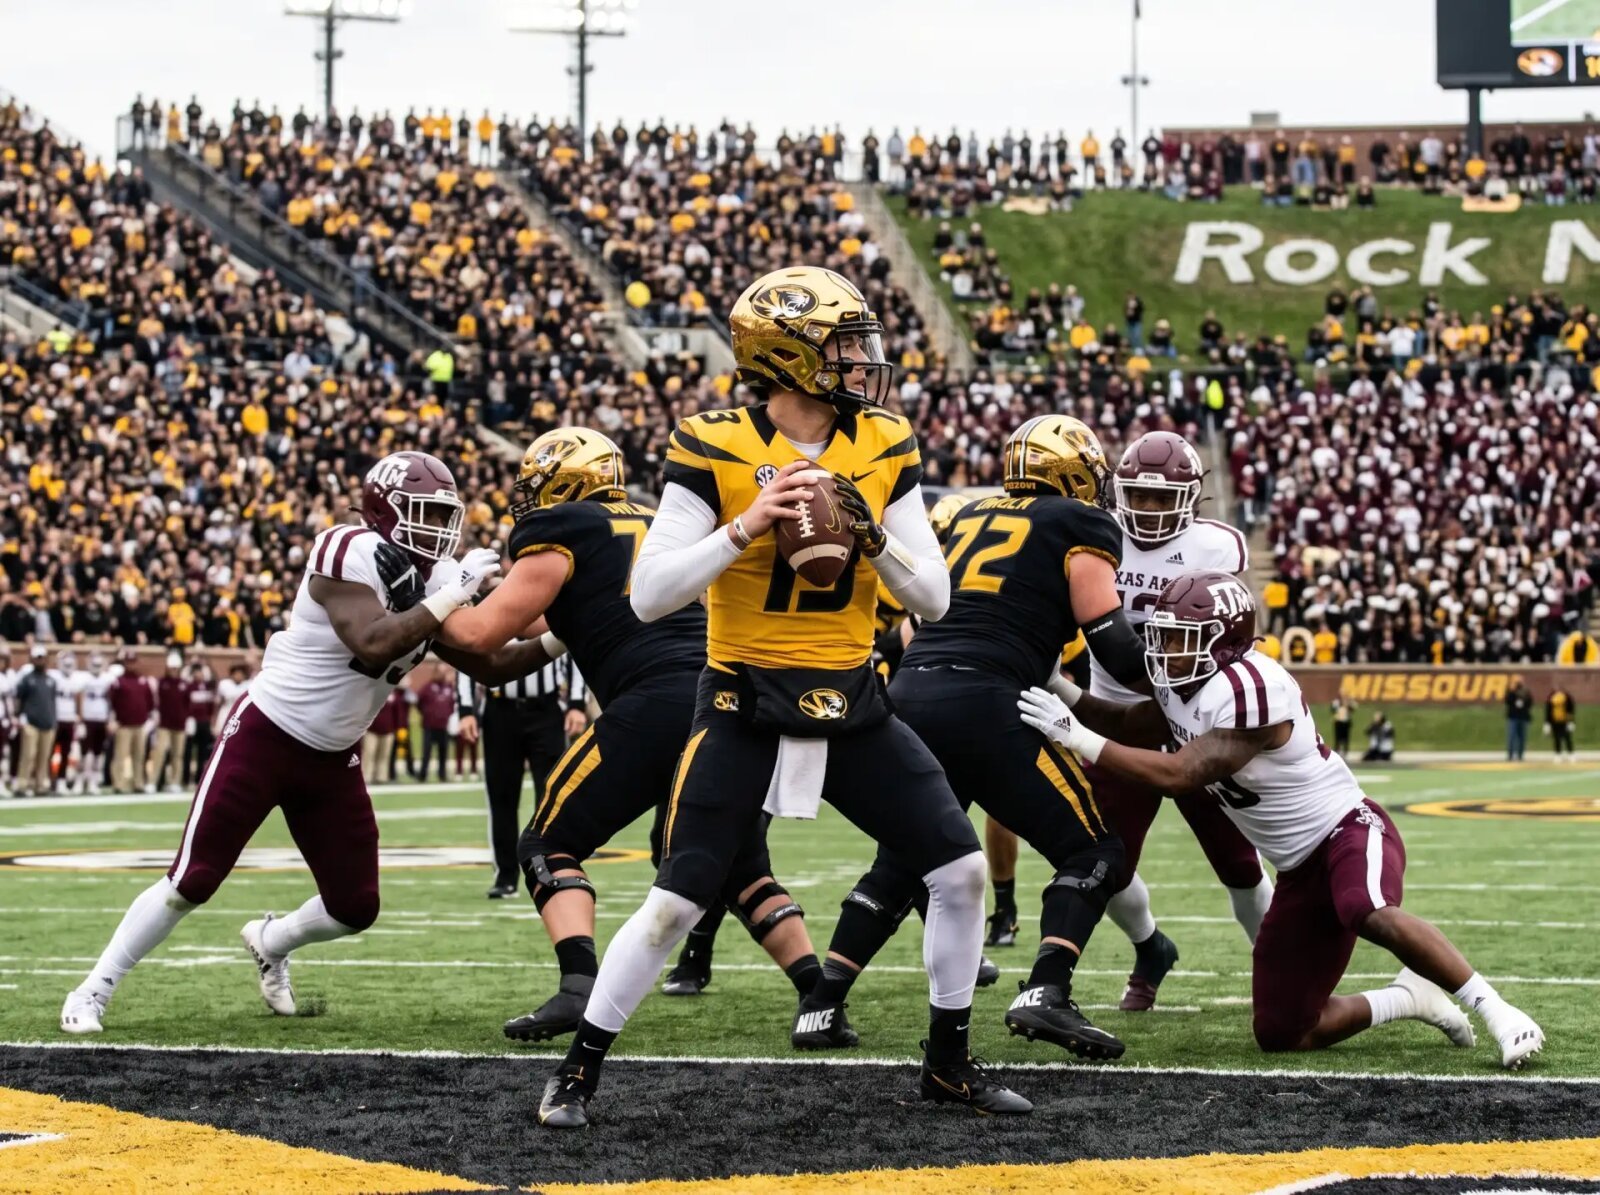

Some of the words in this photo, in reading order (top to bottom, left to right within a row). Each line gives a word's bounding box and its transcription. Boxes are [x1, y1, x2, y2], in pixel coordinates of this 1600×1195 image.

[1174, 221, 1492, 286] Rock
[946, 513, 1032, 593] 72
[1115, 571, 1145, 588] XAS
[1148, 575, 1169, 591] A&
[795, 1007, 836, 1033] NIKE
